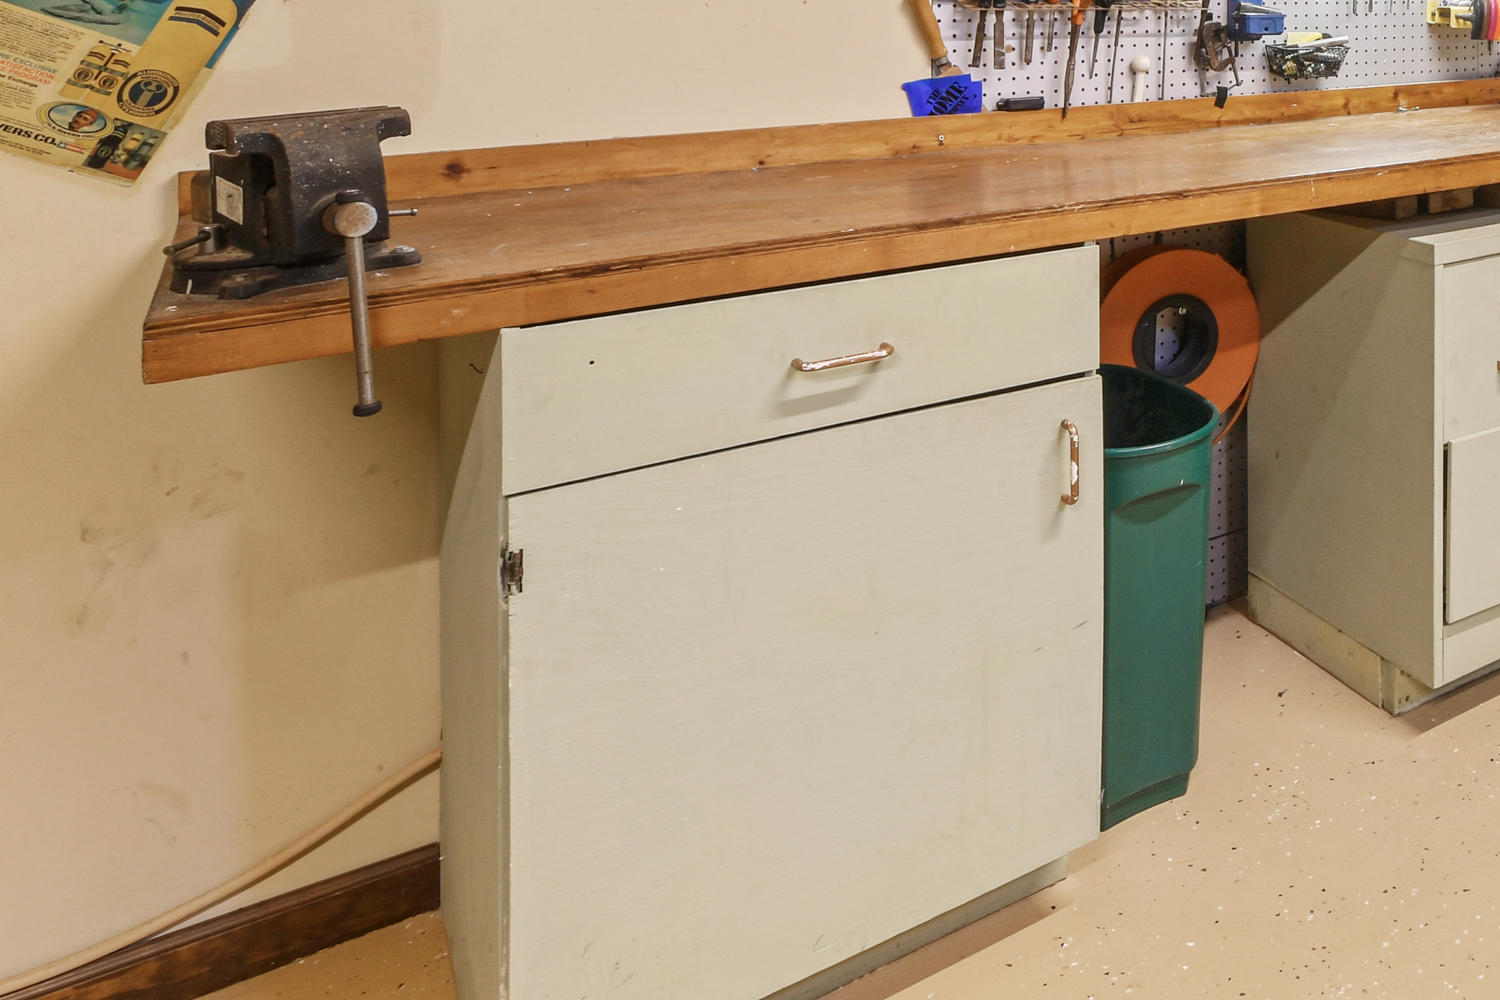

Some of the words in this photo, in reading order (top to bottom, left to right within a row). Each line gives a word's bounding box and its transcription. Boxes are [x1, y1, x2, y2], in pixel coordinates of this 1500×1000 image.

[0, 59, 55, 80] ATISFACTION
[0, 123, 34, 139] VERS
[33, 133, 57, 146] CO.
